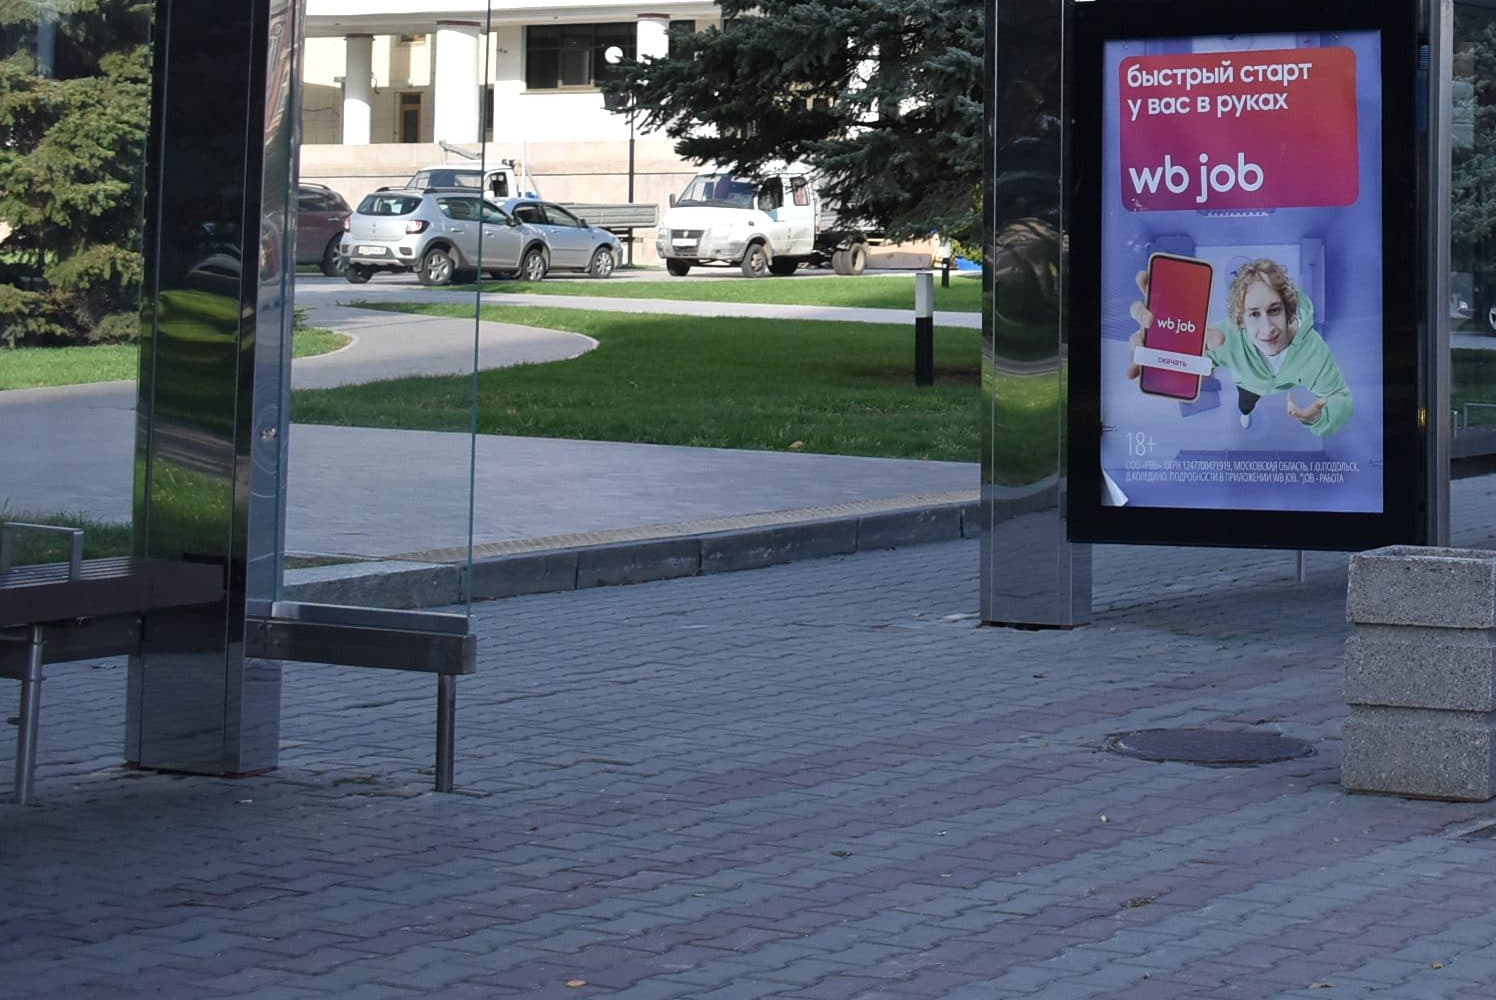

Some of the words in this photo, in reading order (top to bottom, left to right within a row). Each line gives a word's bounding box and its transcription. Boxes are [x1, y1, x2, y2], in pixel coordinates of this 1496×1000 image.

[1127, 60, 1234, 90] быстрый
[1239, 62, 1313, 86] старт
[1128, 99, 1142, 121] у
[1148, 96, 1190, 115] вас
[1197, 96, 1211, 113] в
[1216, 92, 1289, 118] руках
[1129, 154, 1190, 194] wb
[1196, 152, 1264, 203] job
[1158, 317, 1175, 330] wb
[1175, 319, 1196, 334] job
[1158, 356, 1187, 367] скачать
[1125, 431, 1157, 456] 18+
[1234, 461, 1278, 471] МОСКОВСКАЯ
[1320, 473, 1344, 482] РАБОТА
